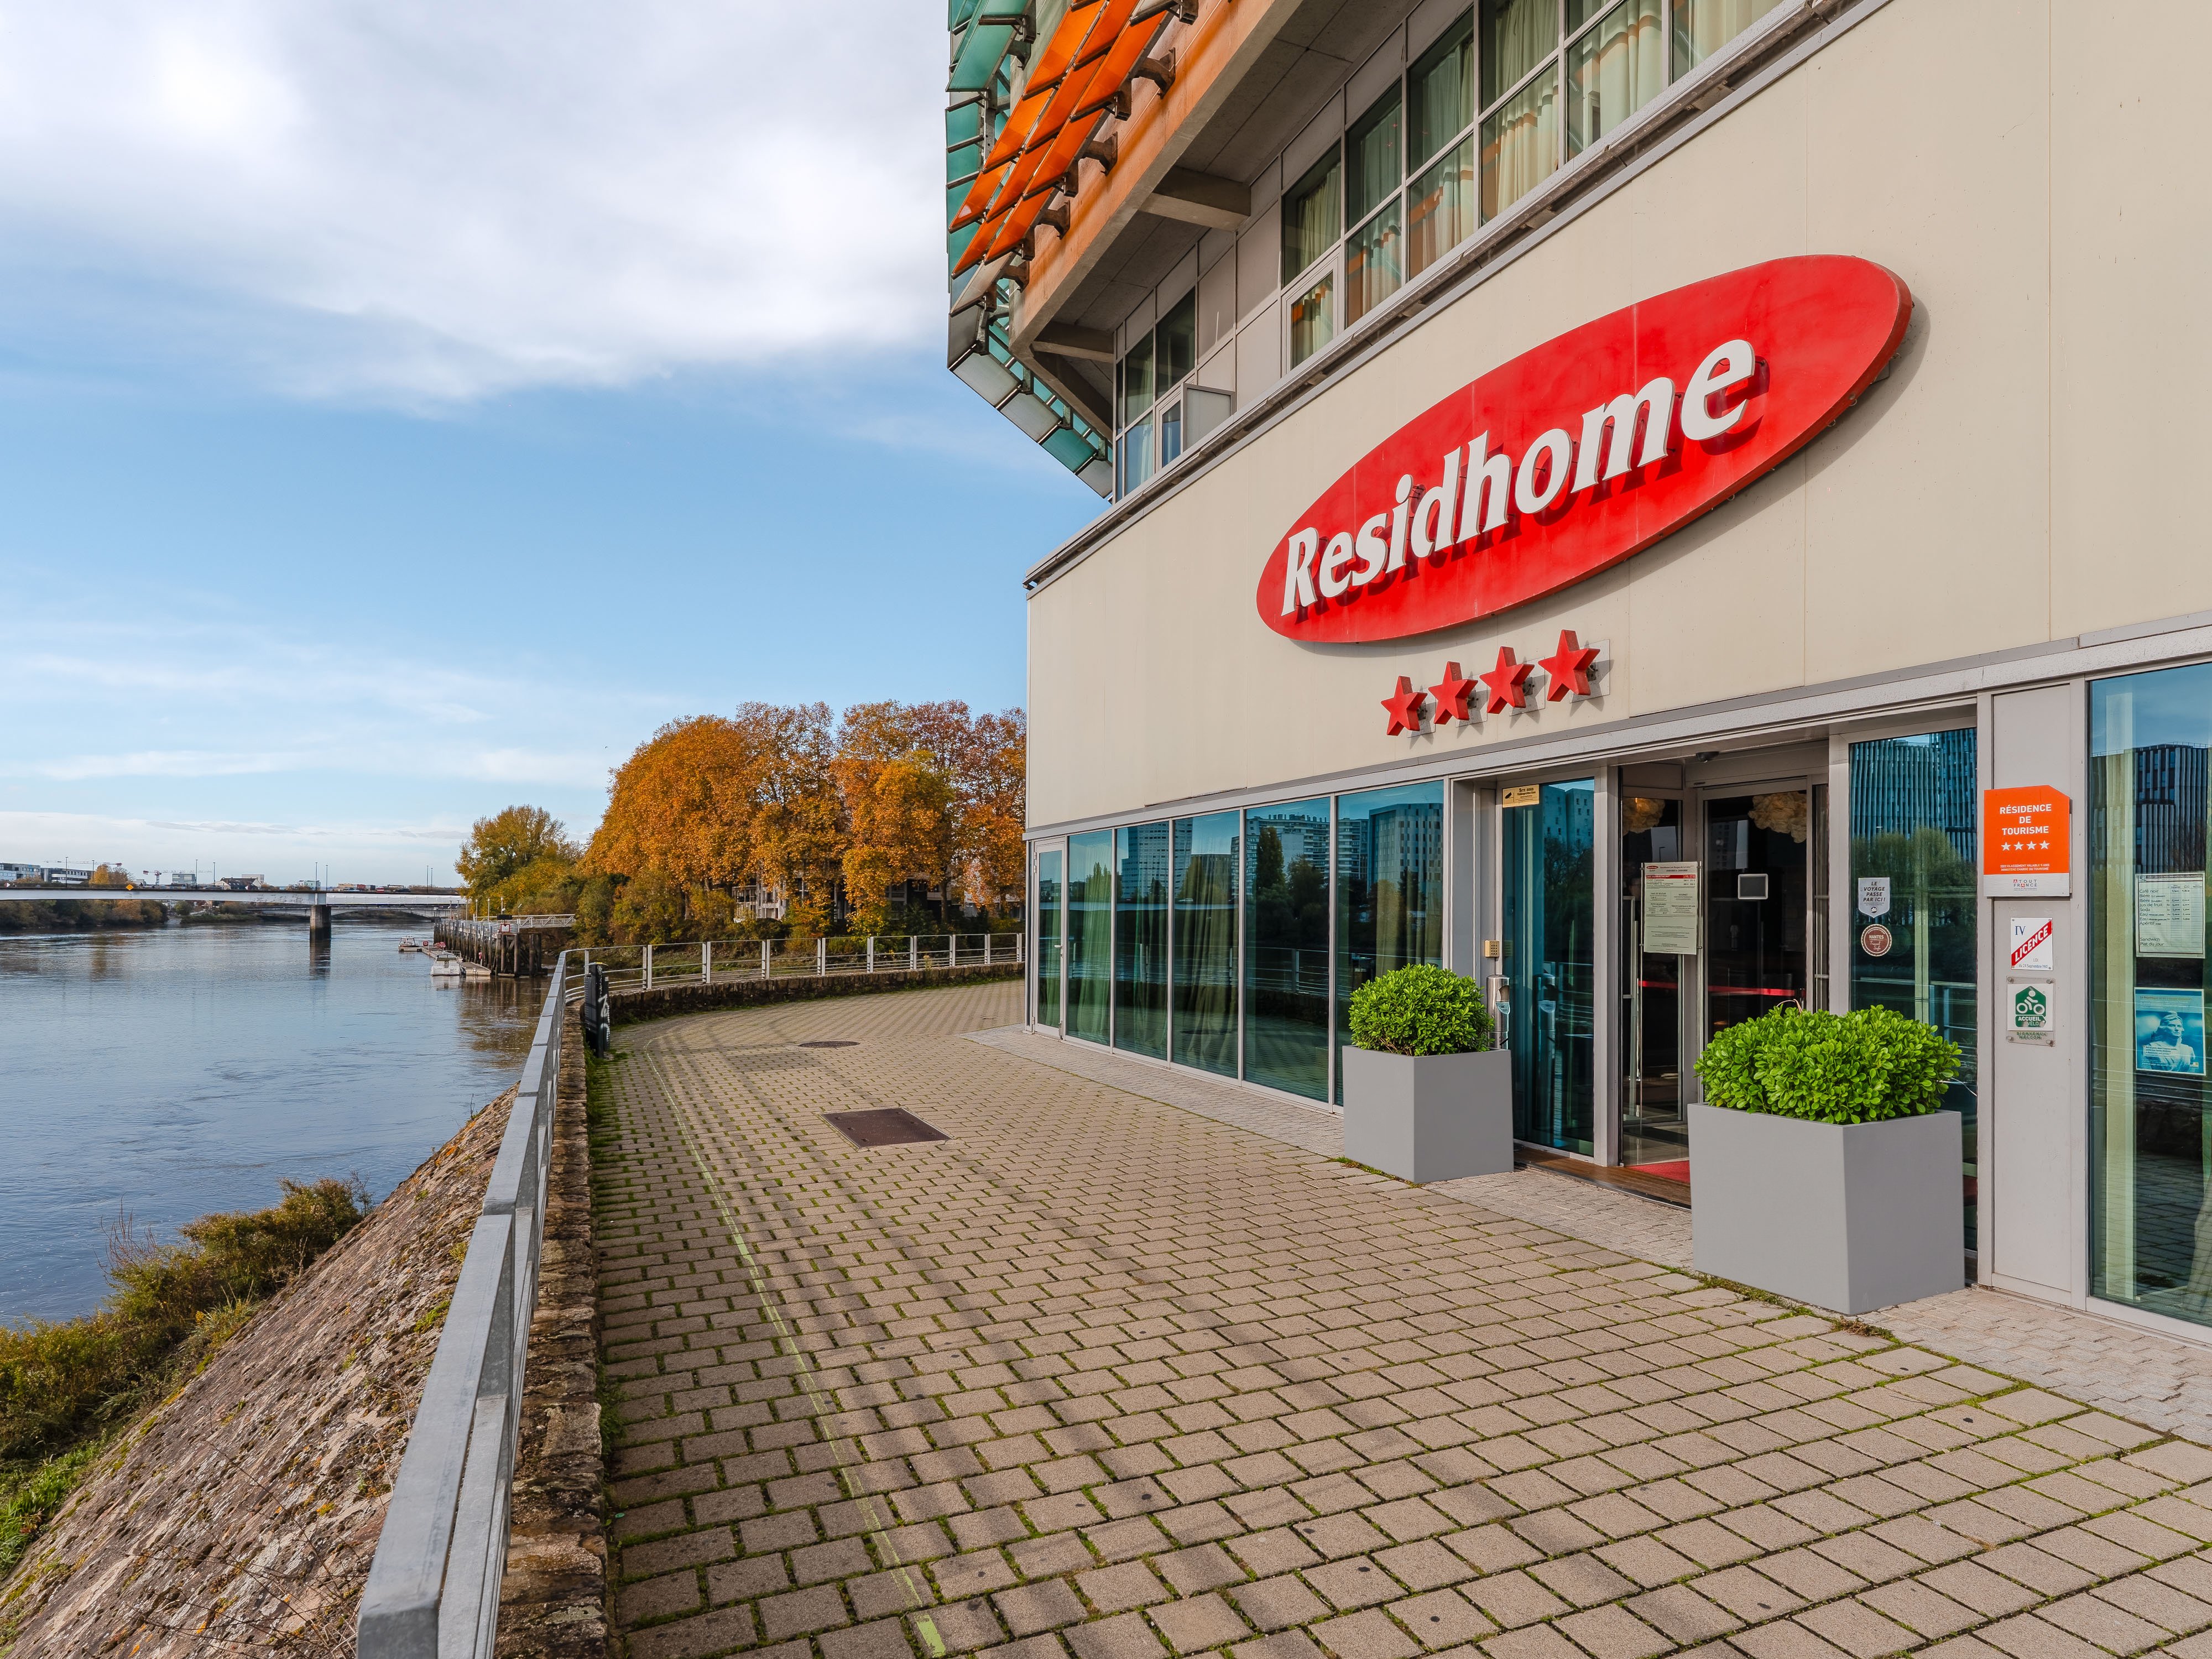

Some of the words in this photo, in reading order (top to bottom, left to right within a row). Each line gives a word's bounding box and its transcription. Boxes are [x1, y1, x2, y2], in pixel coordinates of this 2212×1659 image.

[1281, 338, 1756, 617] Residhome
[2000, 804, 2052, 814] RÉSIDENCE
[2002, 826, 2049, 836] TOURISME
[2015, 926, 2026, 935] IV
[2015, 925, 2048, 962] LICENCE
